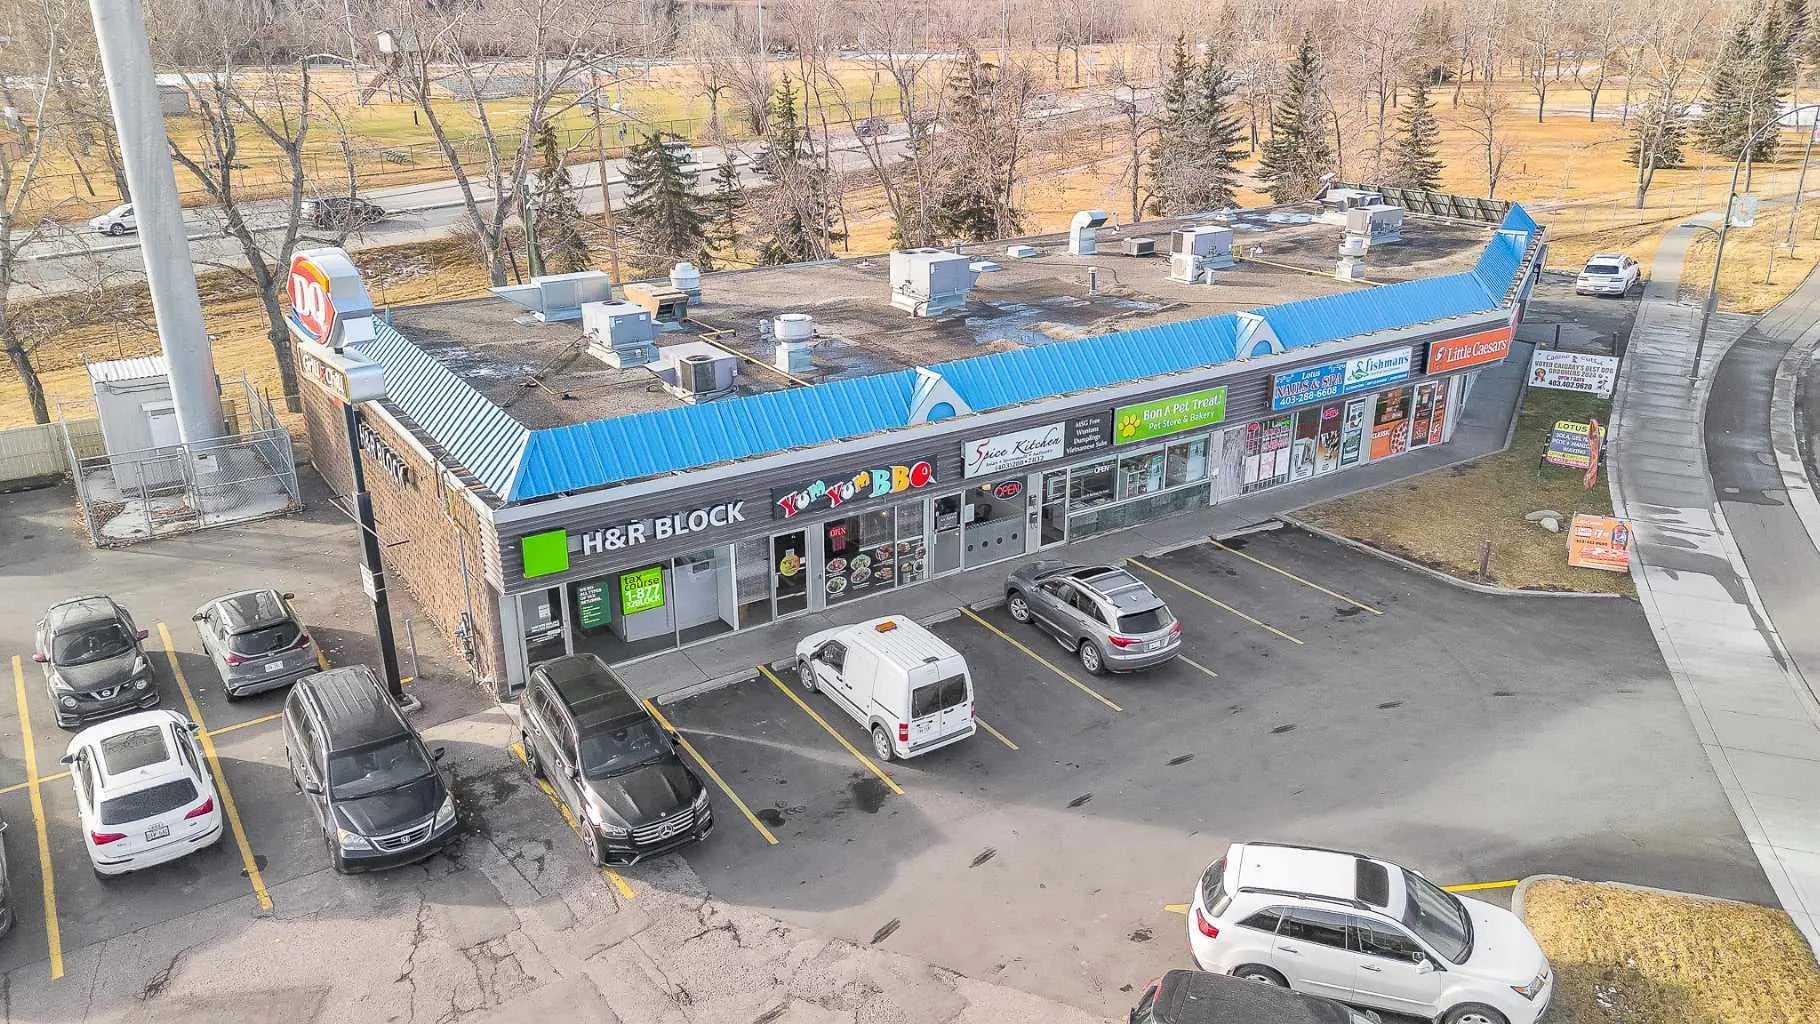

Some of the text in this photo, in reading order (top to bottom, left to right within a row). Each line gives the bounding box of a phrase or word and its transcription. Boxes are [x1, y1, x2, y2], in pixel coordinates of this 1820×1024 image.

[292, 272, 327, 325] DQ
[1447, 340, 1507, 362] Little Caesars
[1365, 356, 1409, 372] fishmans
[1301, 371, 1321, 380] Lotus
[1276, 380, 1309, 398] NAILS
[1310, 380, 1320, 390] &
[1321, 373, 1343, 389] SPA
[1280, 386, 1338, 405] 403-288-6608
[1143, 394, 1222, 421] Bon A Pet Treat!
[1149, 422, 1161, 430] Pet
[1162, 417, 1182, 428] Store
[1191, 411, 1215, 422] Bakery
[1557, 422, 1587, 432] LOTUS
[967, 438, 1008, 474] Spice
[1012, 427, 1062, 455] Kitchen
[776, 460, 937, 519] Yum Yum BBQ
[996, 483, 1021, 497] OPEN
[583, 500, 746, 557] H&R BLOCK
[624, 574, 642, 585] tax
[625, 577, 660, 592] course
[625, 583, 660, 603] 1-877
